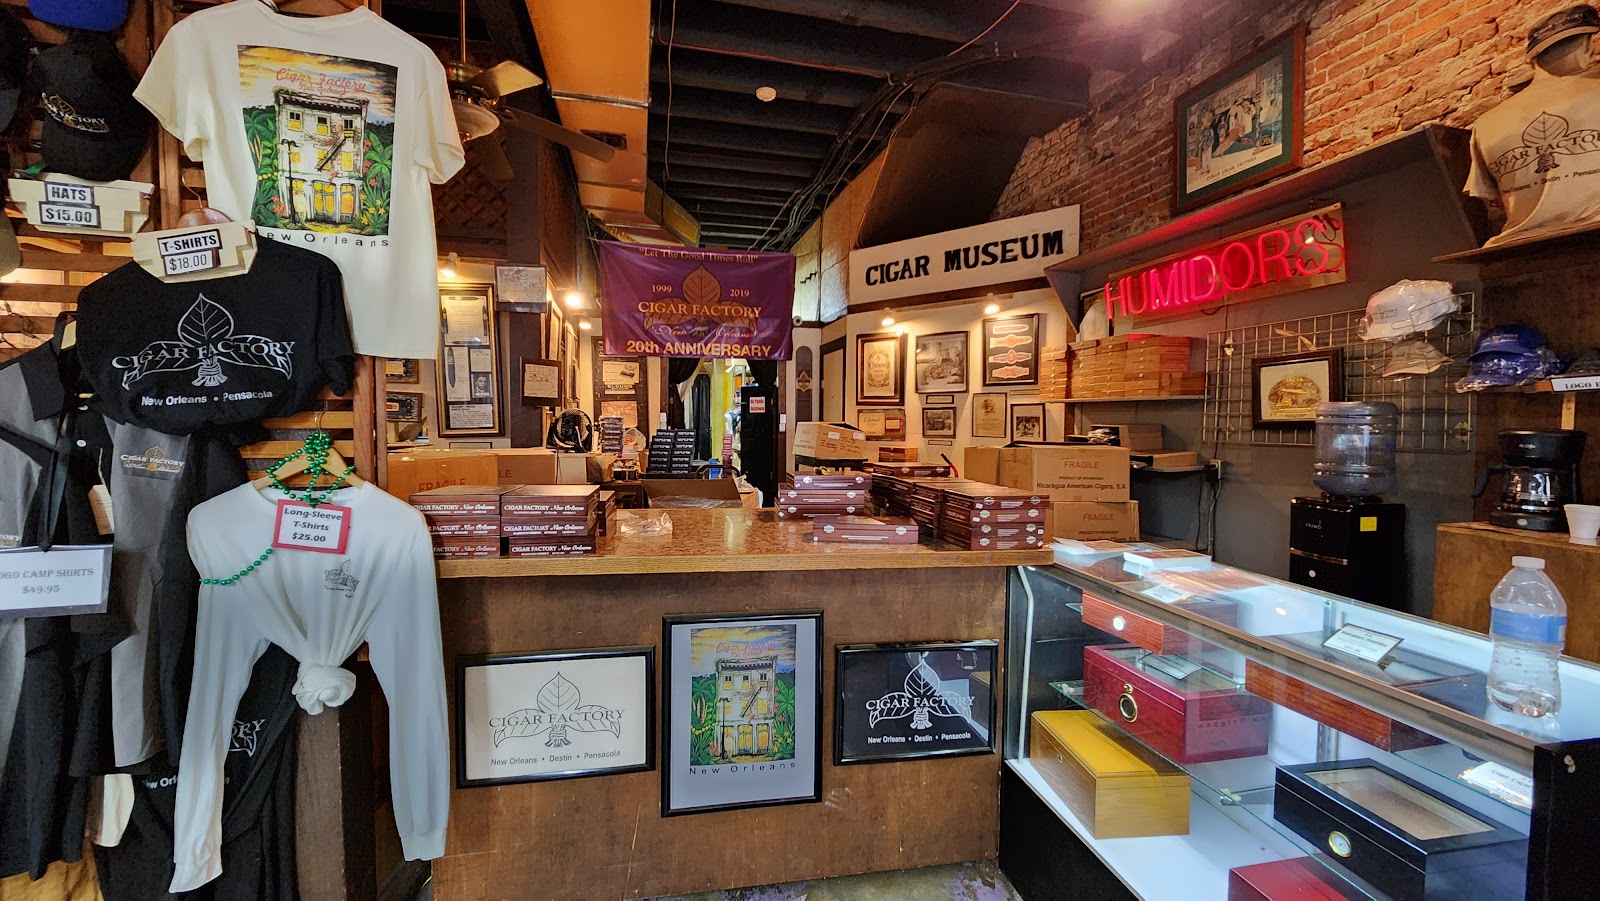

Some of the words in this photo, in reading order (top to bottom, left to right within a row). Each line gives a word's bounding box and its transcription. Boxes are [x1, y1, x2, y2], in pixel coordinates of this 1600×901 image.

[276, 67, 312, 84] Cigar
[316, 73, 367, 92] Factory
[51, 186, 87, 201] HATS
[45, 207, 92, 223] $15.00
[162, 234, 217, 252] T-SHIRTS
[266, 231, 291, 242] ew
[304, 233, 389, 247] Orleans
[169, 253, 207, 271] $18.00
[661, 249, 679, 258] The
[681, 251, 705, 260] Good
[707, 252, 734, 262] Times
[866, 255, 930, 286] CIGAR
[944, 230, 1064, 273] MUSEUM
[1104, 218, 1329, 320] HUMIDORS
[651, 285, 672, 293] 1999
[730, 289, 750, 297] 2019
[638, 301, 688, 315] CIGAR
[692, 303, 762, 317] FACTORY
[112, 347, 191, 369] CIGAR
[197, 341, 296, 360] FACTORY
[627, 340, 660, 353] 20th
[663, 341, 772, 357] ANNIVERSARY
[141, 395, 164, 406] New
[165, 395, 207, 405] Orleans
[223, 390, 273, 402] Pensacola
[120, 454, 147, 462] CIGAR
[149, 457, 185, 467] FACTORY
[1064, 461, 1100, 469] FRAGILE
[284, 507, 342, 520] Long-Sleeve
[293, 521, 329, 531] T-Shirts
[292, 532, 326, 542] $25.00
[22, 570, 54, 579] CAMP
[56, 568, 94, 577] SHIRTS
[22, 585, 60, 595] $49.95
[865, 698, 910, 710] CIGAR
[913, 696, 976, 708] FACTORY
[489, 715, 543, 728] CIGAR
[548, 709, 626, 725] FACTORY
[868, 736, 882, 744] New
[883, 735, 906, 743] Orleans
[914, 734, 933, 742] Destin
[941, 731, 971, 740] Pensacola
[490, 758, 508, 766] New
[509, 757, 538, 765] Orleans
[549, 754, 572, 762] Destin
[583, 750, 621, 760] Pensacola
[730, 762, 796, 773] Orleans
